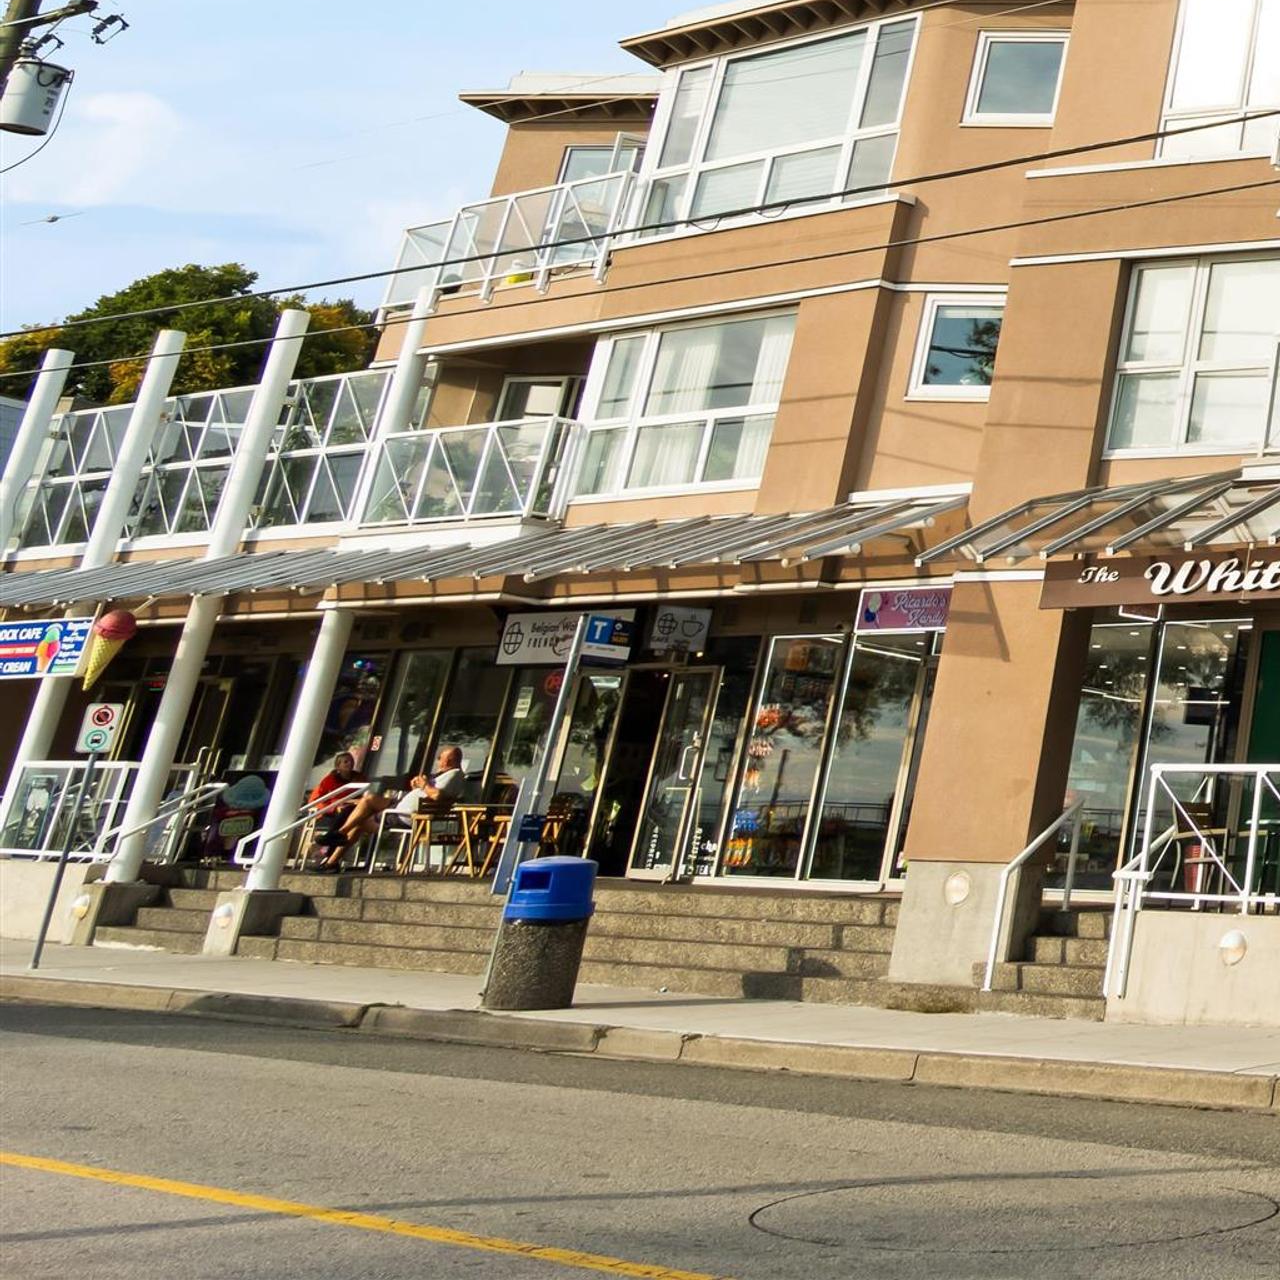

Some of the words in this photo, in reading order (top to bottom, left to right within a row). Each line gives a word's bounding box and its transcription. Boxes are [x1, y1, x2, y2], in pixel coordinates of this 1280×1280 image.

[1077, 566, 1120, 584] The
[891, 592, 946, 613] Ricardo's
[0, 628, 20, 641] OCK
[19, 627, 43, 640] CAFE
[3, 661, 33, 674] CREAM
